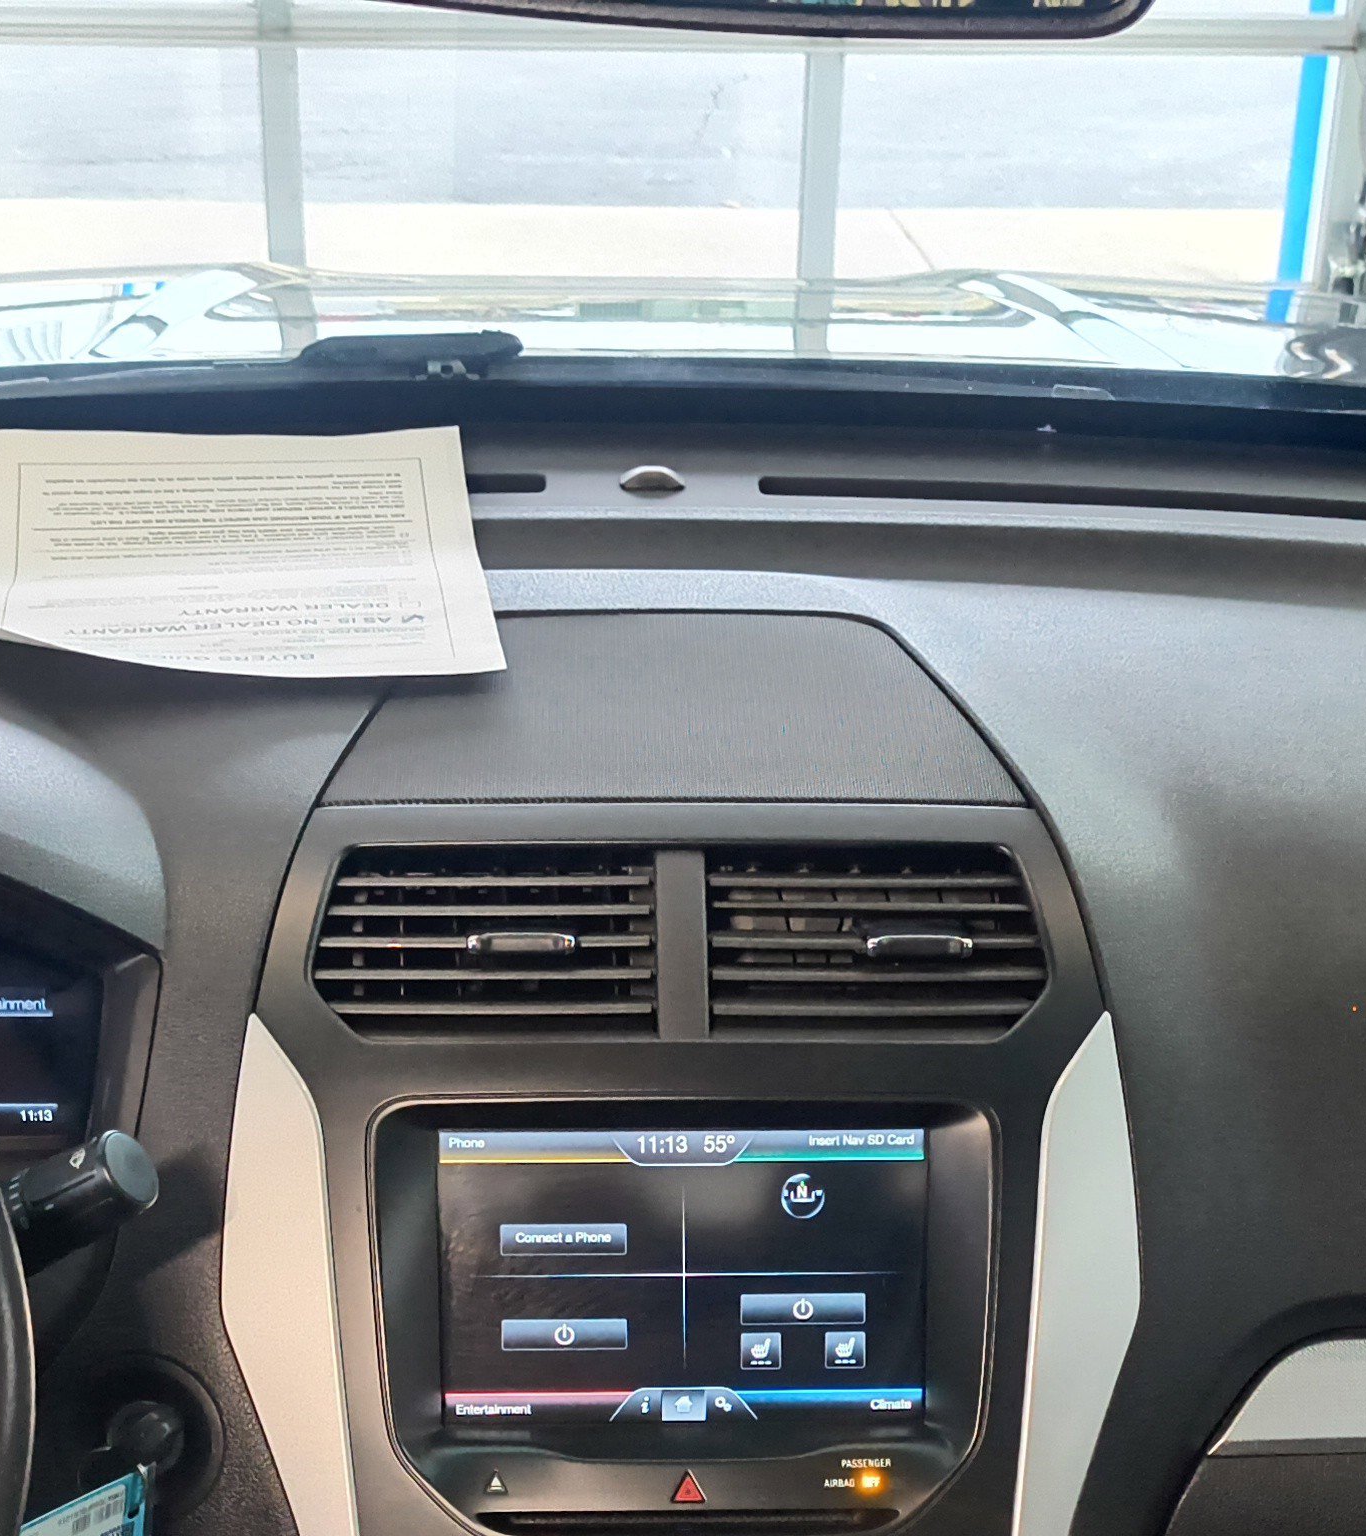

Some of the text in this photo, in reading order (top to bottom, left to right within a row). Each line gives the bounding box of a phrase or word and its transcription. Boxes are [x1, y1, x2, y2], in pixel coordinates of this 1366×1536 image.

[179, 602, 389, 616] DEALER WARRANTY
[195, 620, 280, 631] DEALER
[287, 618, 318, 626] NO
[337, 616, 356, 624] IS
[363, 616, 392, 624] AS
[64, 624, 187, 636] WARRANTY
[218, 653, 315, 662] BUYERS
[20, 1109, 53, 1122] 11:13
[448, 1137, 485, 1149] Phone
[637, 1135, 688, 1154] 11:13
[808, 1133, 915, 1146] Insert Nav SD Card
[797, 1185, 808, 1197] N
[515, 1231, 612, 1244] Connect a Phone
[455, 1403, 532, 1416] Entertainment
[870, 1398, 912, 1411] Climate
[841, 1458, 892, 1468] PASSENGER
[823, 1478, 856, 1488] AIRBAG
